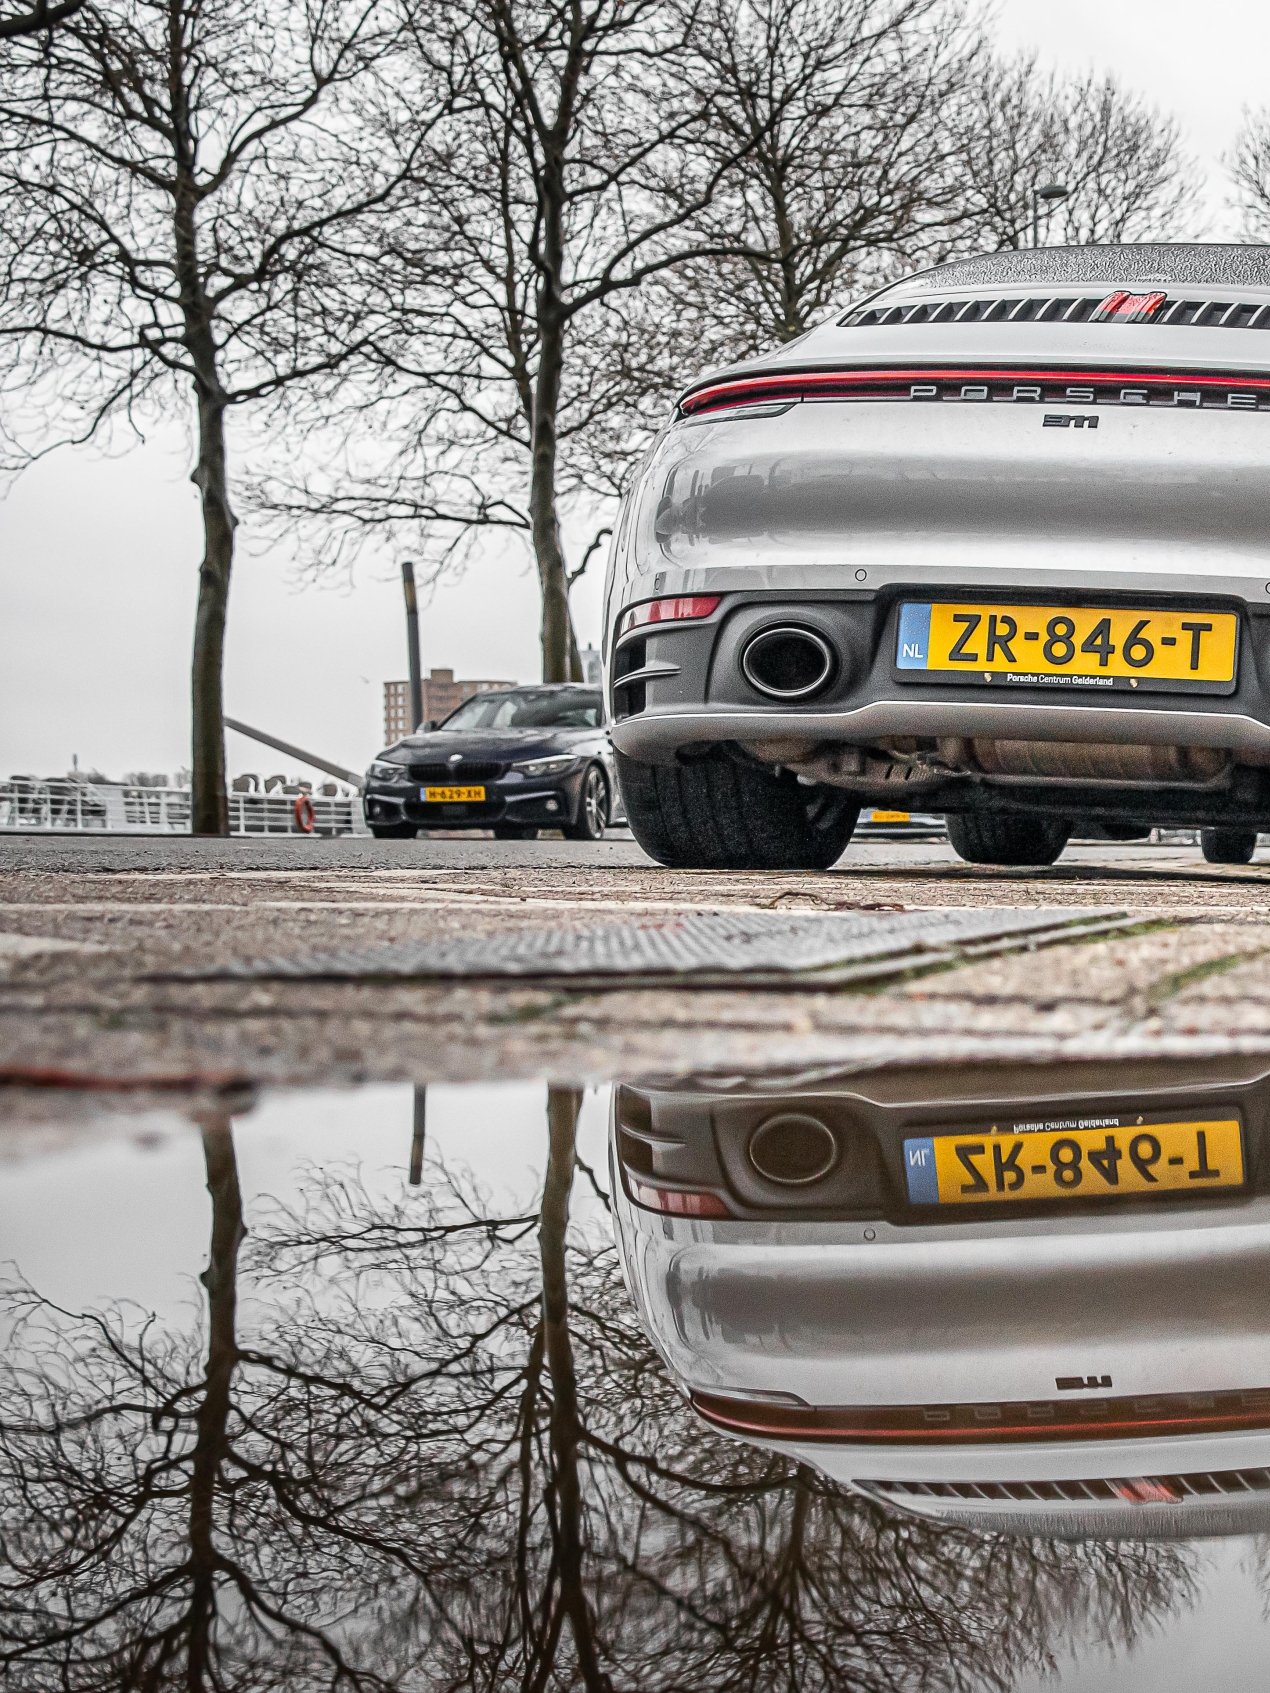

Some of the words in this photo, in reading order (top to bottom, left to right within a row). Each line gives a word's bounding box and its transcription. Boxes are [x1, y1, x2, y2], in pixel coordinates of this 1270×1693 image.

[910, 385, 1257, 409] PORSCHE
[1042, 413, 1099, 429] 911
[948, 612, 1213, 671] ZR-846-T
[902, 643, 924, 660] NL
[1007, 673, 1038, 683] Porsche
[1039, 674, 1071, 684] Centrum
[1072, 675, 1114, 686] Gelderland
